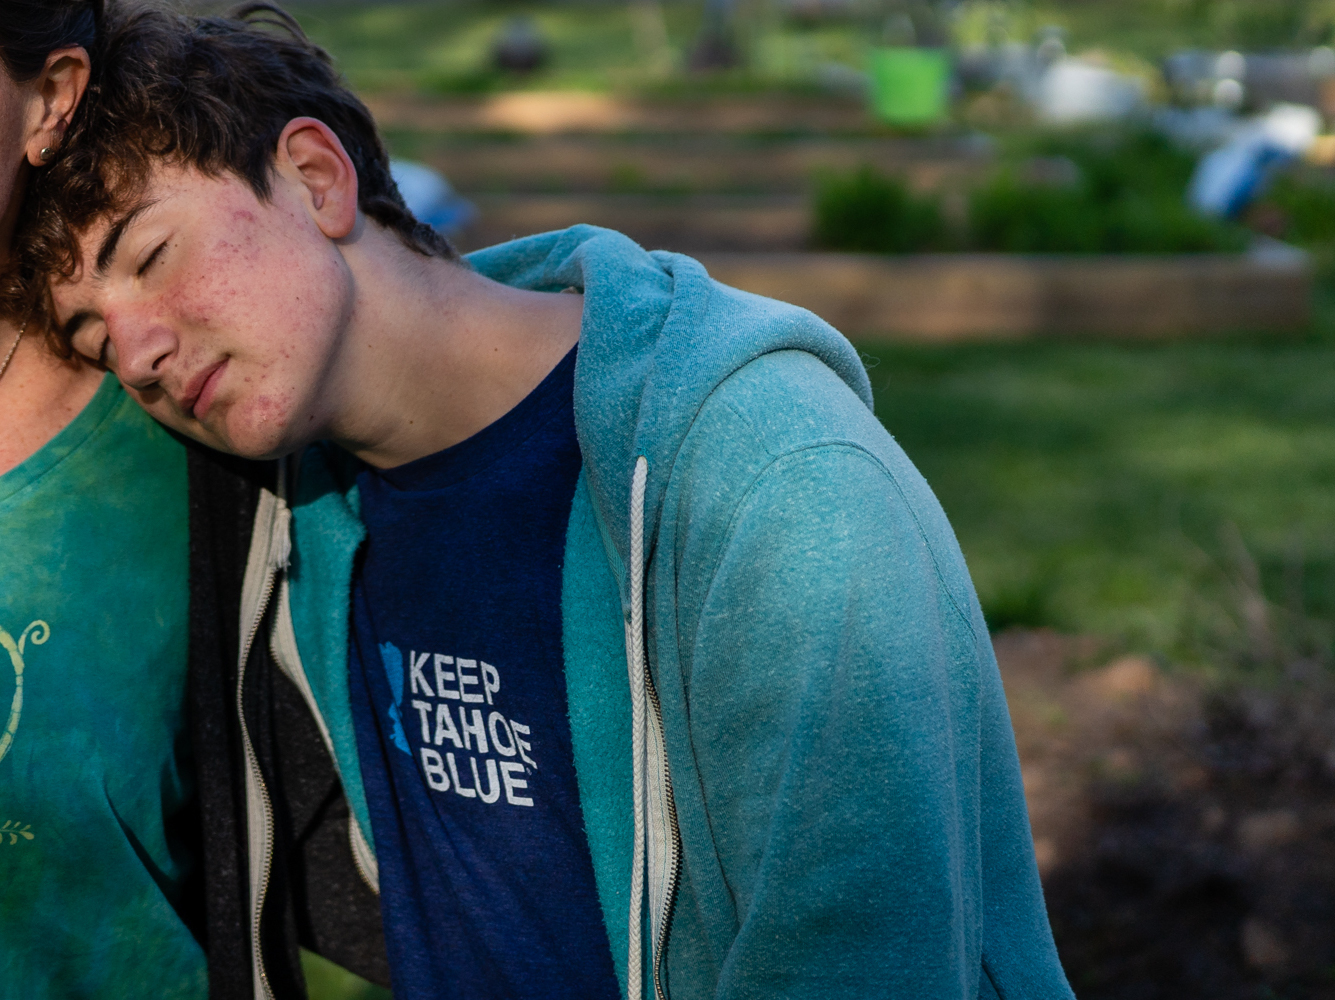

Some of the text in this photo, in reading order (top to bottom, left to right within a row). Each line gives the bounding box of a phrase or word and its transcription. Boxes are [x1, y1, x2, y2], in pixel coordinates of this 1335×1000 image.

[409, 650, 500, 705] KEEP
[411, 699, 538, 770] TAHOE
[420, 747, 535, 807] BLUE
